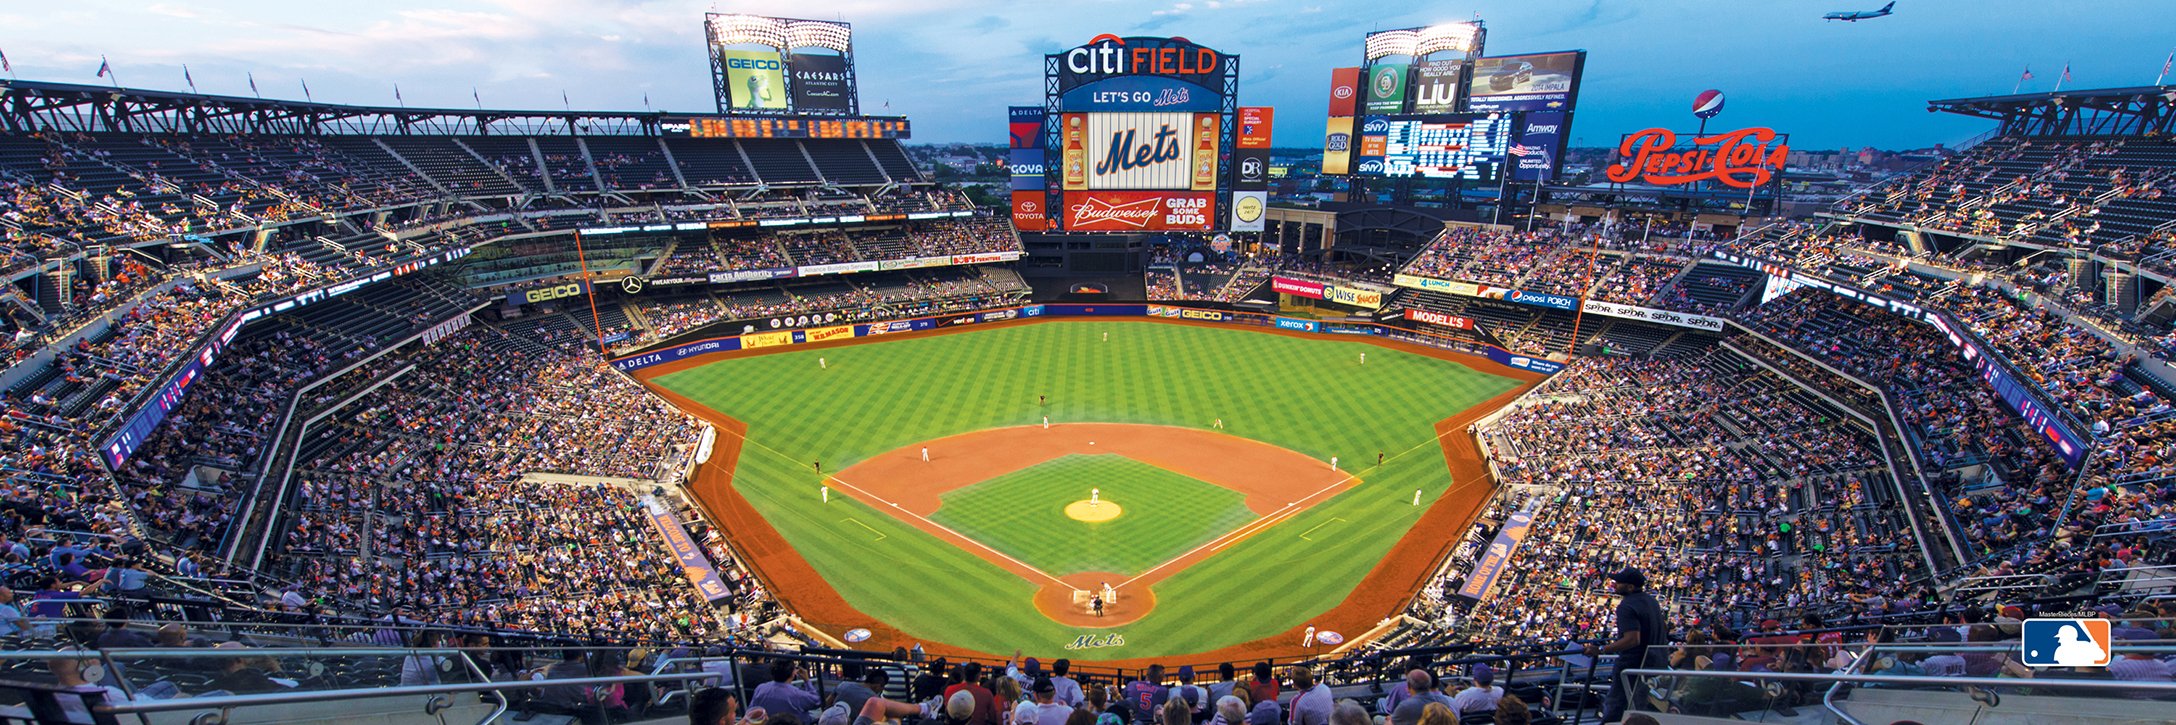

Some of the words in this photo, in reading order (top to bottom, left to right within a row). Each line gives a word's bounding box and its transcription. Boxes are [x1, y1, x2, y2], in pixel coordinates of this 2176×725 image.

[728, 58, 780, 70] GEICO
[1068, 41, 1123, 74] citi
[1132, 48, 1216, 74] FIELD
[796, 71, 845, 80] CAESARS
[1093, 92, 1128, 103] LET'S
[1133, 92, 1151, 103] GO
[1153, 87, 1189, 106] Mets
[1417, 83, 1455, 104] LIU
[1527, 123, 1558, 134] Amway
[1096, 123, 1180, 176] Mets
[1011, 164, 1043, 175] GOYA
[1072, 204, 1158, 220] Budweiser
[1166, 198, 1207, 208] GRAB
[1166, 215, 1205, 224] BUDS
[710, 273, 733, 282] Parts
[734, 270, 772, 280] Authority
[526, 283, 580, 303] GEICO
[1336, 289, 1355, 302] WISE
[1357, 294, 1379, 304] SNACKS
[1547, 297, 1571, 306] PORCH
[1028, 306, 1039, 316] citi
[1182, 310, 1222, 320] GEICO
[1413, 311, 1464, 327] MODELL'S
[688, 342, 719, 353] HYUNDAI
[628, 354, 661, 367] DELTA
[1465, 573, 1488, 595] HOME
[1064, 633, 1124, 650] Mets
[1139, 692, 1152, 710] 5
